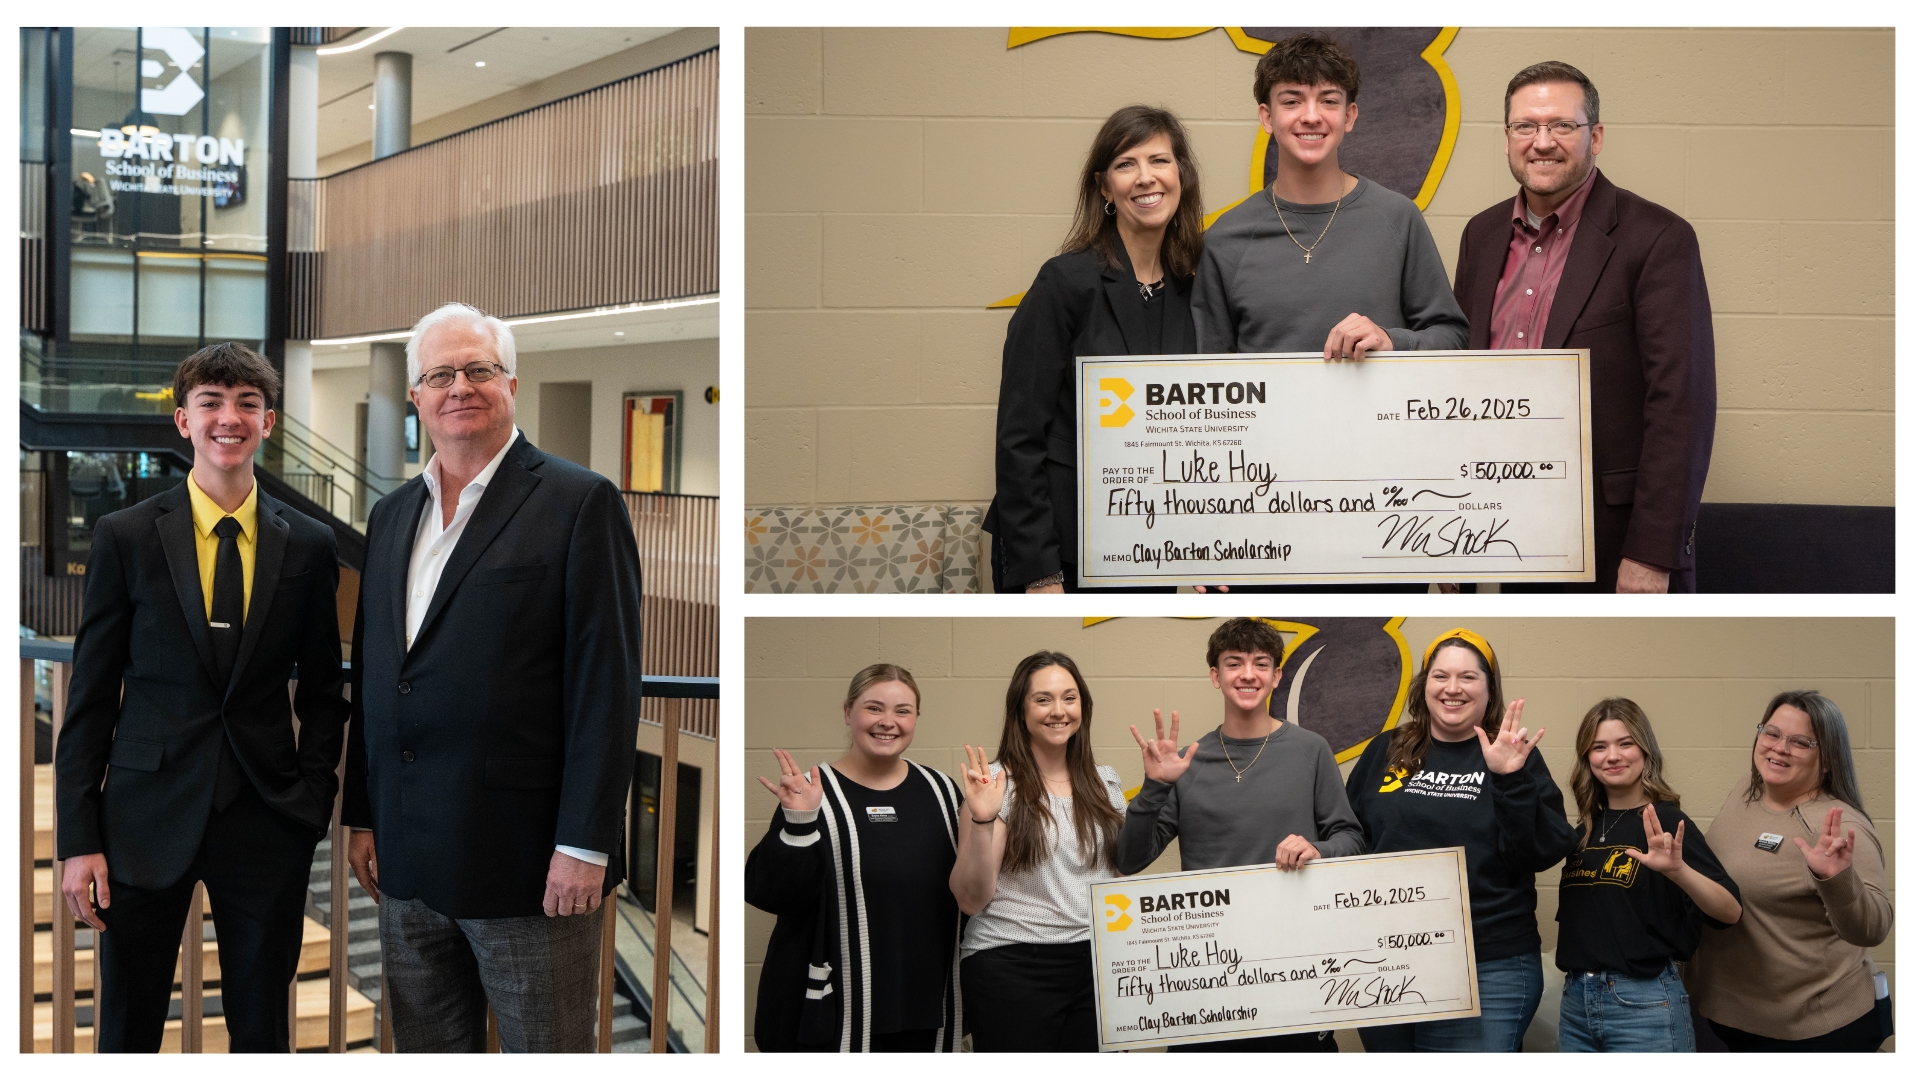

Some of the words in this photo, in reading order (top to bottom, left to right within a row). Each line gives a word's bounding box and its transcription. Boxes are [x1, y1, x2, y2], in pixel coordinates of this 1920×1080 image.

[100, 128, 244, 166] BARTON
[105, 160, 155, 177] School
[157, 164, 175, 178] of
[176, 164, 238, 183] Business
[1146, 382, 1266, 405] BARTON
[1146, 409, 1186, 420] School
[1189, 409, 1202, 419] of
[1204, 408, 1257, 420] Business
[1377, 413, 1400, 421] DATE
[1407, 399, 1440, 420] Feb
[1185, 439, 1211, 447] Wichita,
[1103, 467, 1120, 475] PAY
[1137, 466, 1155, 474] THE
[1163, 449, 1221, 483] Luke
[1229, 449, 1278, 496] Hoy
[1460, 463, 1468, 478] $
[1137, 476, 1149, 484] OF
[1108, 488, 1155, 529] Fifty
[1163, 489, 1255, 515] thousand
[1268, 491, 1334, 513] dollars
[1339, 492, 1376, 513] and
[1458, 502, 1502, 510] DOLLARS
[1133, 543, 1161, 569] Clay
[1164, 540, 1210, 562] Barton
[1214, 538, 1292, 562] Scholarship
[1410, 770, 1485, 785] BARTON
[1404, 788, 1426, 796] WICHITA
[1444, 792, 1477, 801] UNIVERSITY
[1407, 781, 1435, 790] School
[1446, 784, 1481, 794] Business
[1140, 889, 1231, 913] BARTON
[1335, 892, 1360, 909] Feb
[1141, 913, 1172, 924] School
[1173, 912, 1183, 921] of
[1185, 910, 1224, 921] Business
[1377, 938, 1384, 948] $
[1112, 960, 1125, 968] PAY
[1155, 943, 1201, 970] Luke
[1206, 940, 1243, 974] Hoy
[1112, 967, 1136, 975] ORDER
[1378, 963, 1410, 973] DOLLARS
[1117, 975, 1154, 1005] Fifty
[1159, 971, 1228, 993] thousand
[1238, 966, 1287, 986] dollars
[1290, 965, 1318, 981] and
[1139, 1015, 1160, 1034] Clay
[1162, 1011, 1197, 1028] Barton
[1199, 1005, 1258, 1025] Scholarship
